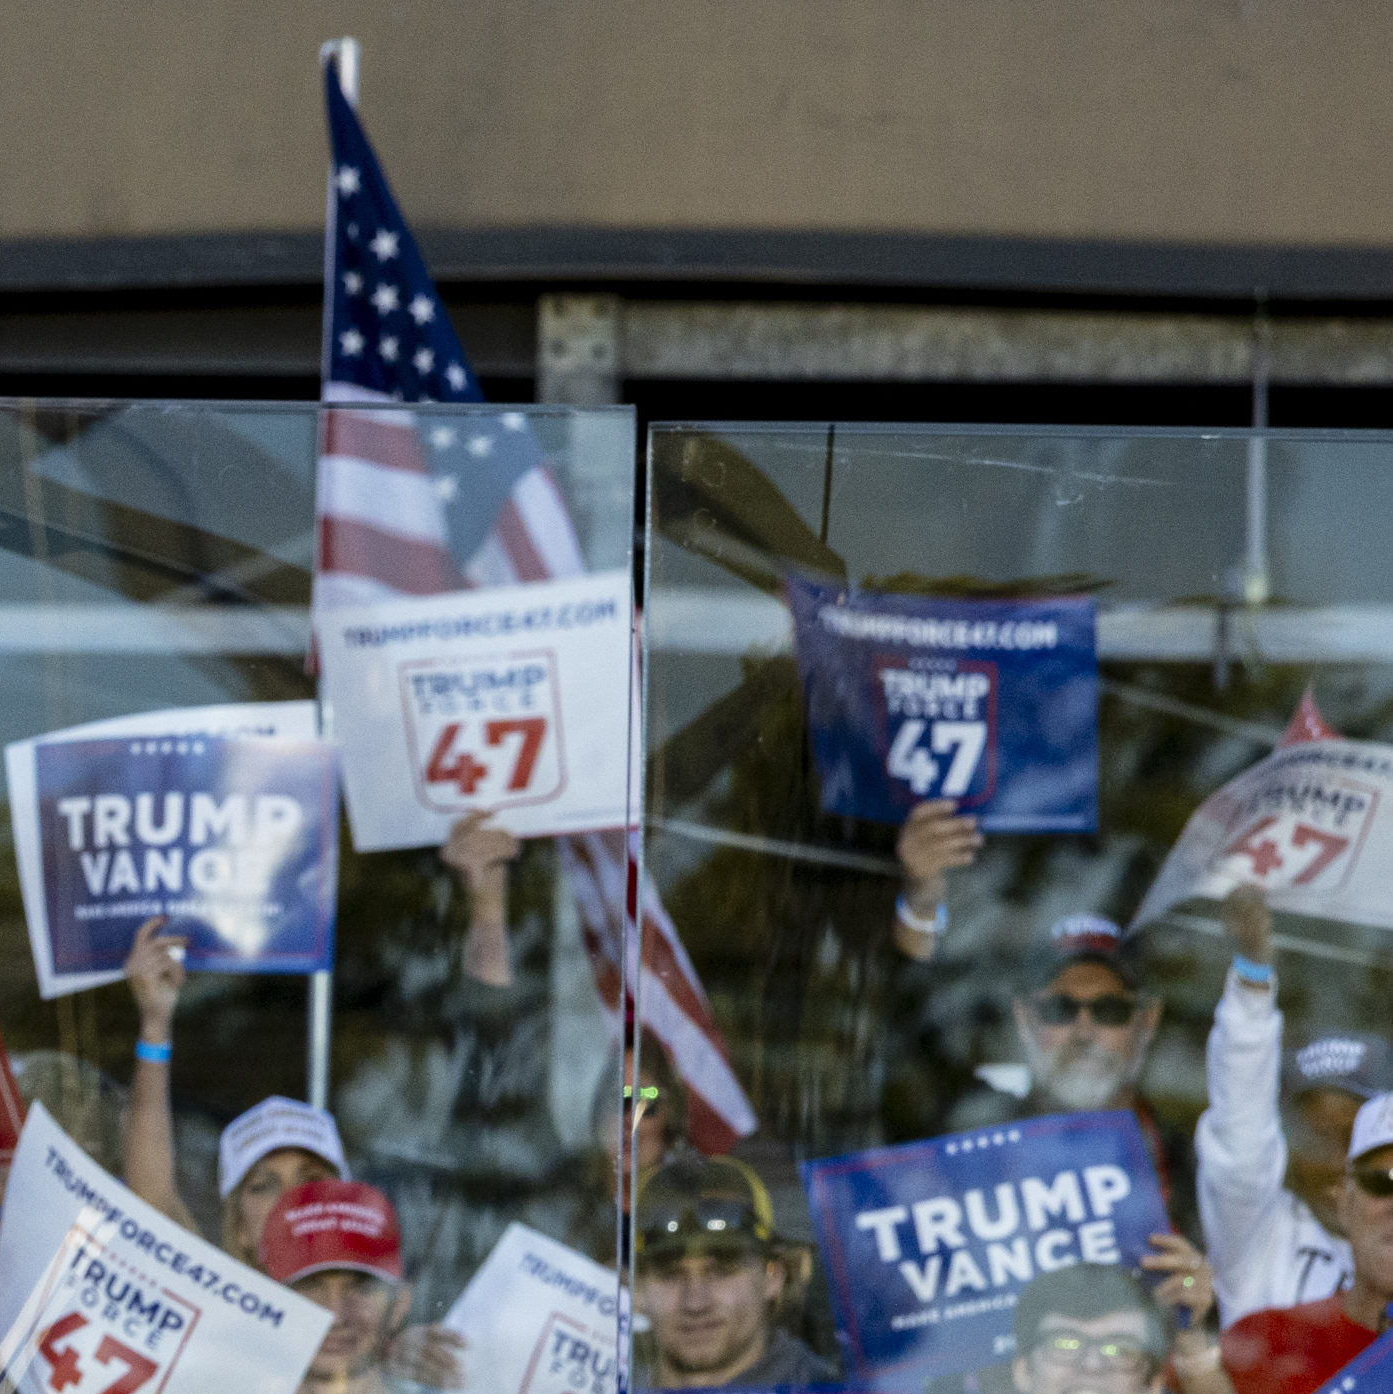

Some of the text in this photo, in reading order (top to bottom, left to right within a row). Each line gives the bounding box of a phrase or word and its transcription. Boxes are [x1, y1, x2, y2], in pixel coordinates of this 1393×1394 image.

[880, 668, 990, 700] TRUMP
[426, 717, 547, 796] 47
[887, 719, 988, 796] 47
[58, 791, 303, 851] TRUMP
[1223, 815, 1350, 887] 47
[80, 848, 270, 897] VANC
[44, 1145, 286, 1329] TRUMPFORCE47.COM
[855, 1164, 1132, 1263] TRUMP
[69, 1247, 184, 1333] TRUMP
[898, 1219, 1121, 1303] VANCE
